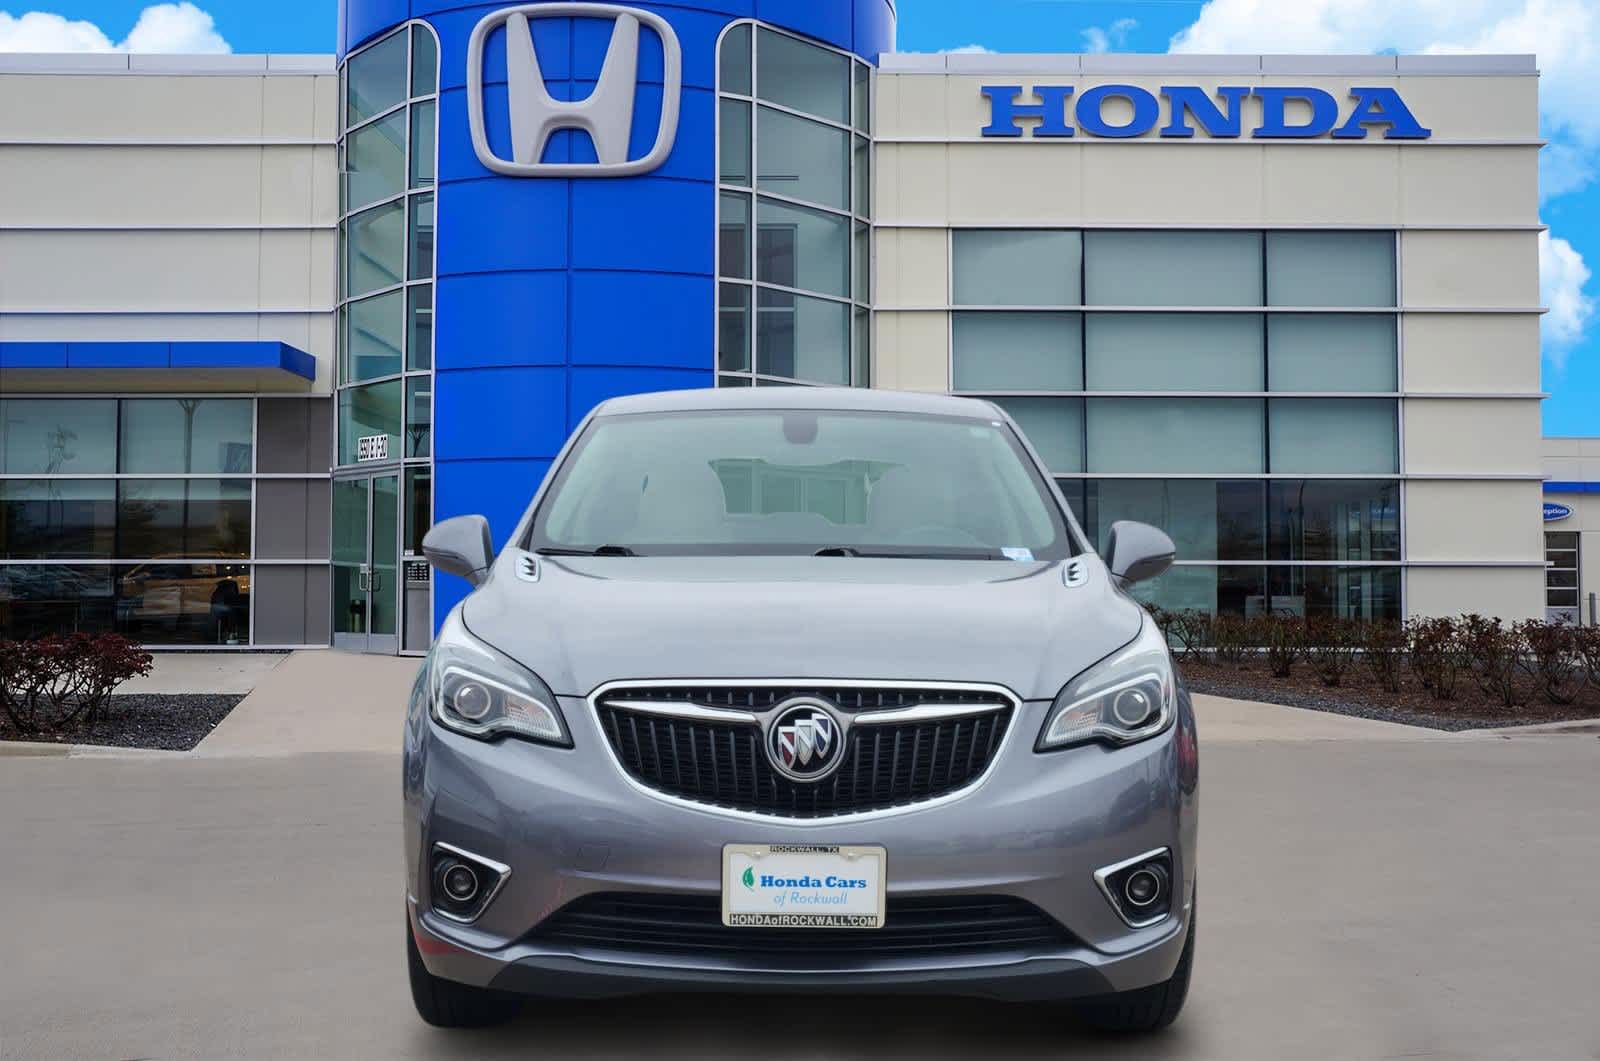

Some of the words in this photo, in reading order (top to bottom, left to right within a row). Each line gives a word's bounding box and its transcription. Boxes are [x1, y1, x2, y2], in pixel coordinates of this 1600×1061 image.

[981, 84, 1432, 139] HONDA
[760, 875, 822, 888] Honda
[825, 876, 867, 888] Cars
[773, 893, 787, 906] of
[790, 892, 848, 905] Rockwall
[730, 914, 879, 927] HONDAofROCKWALL.COM
